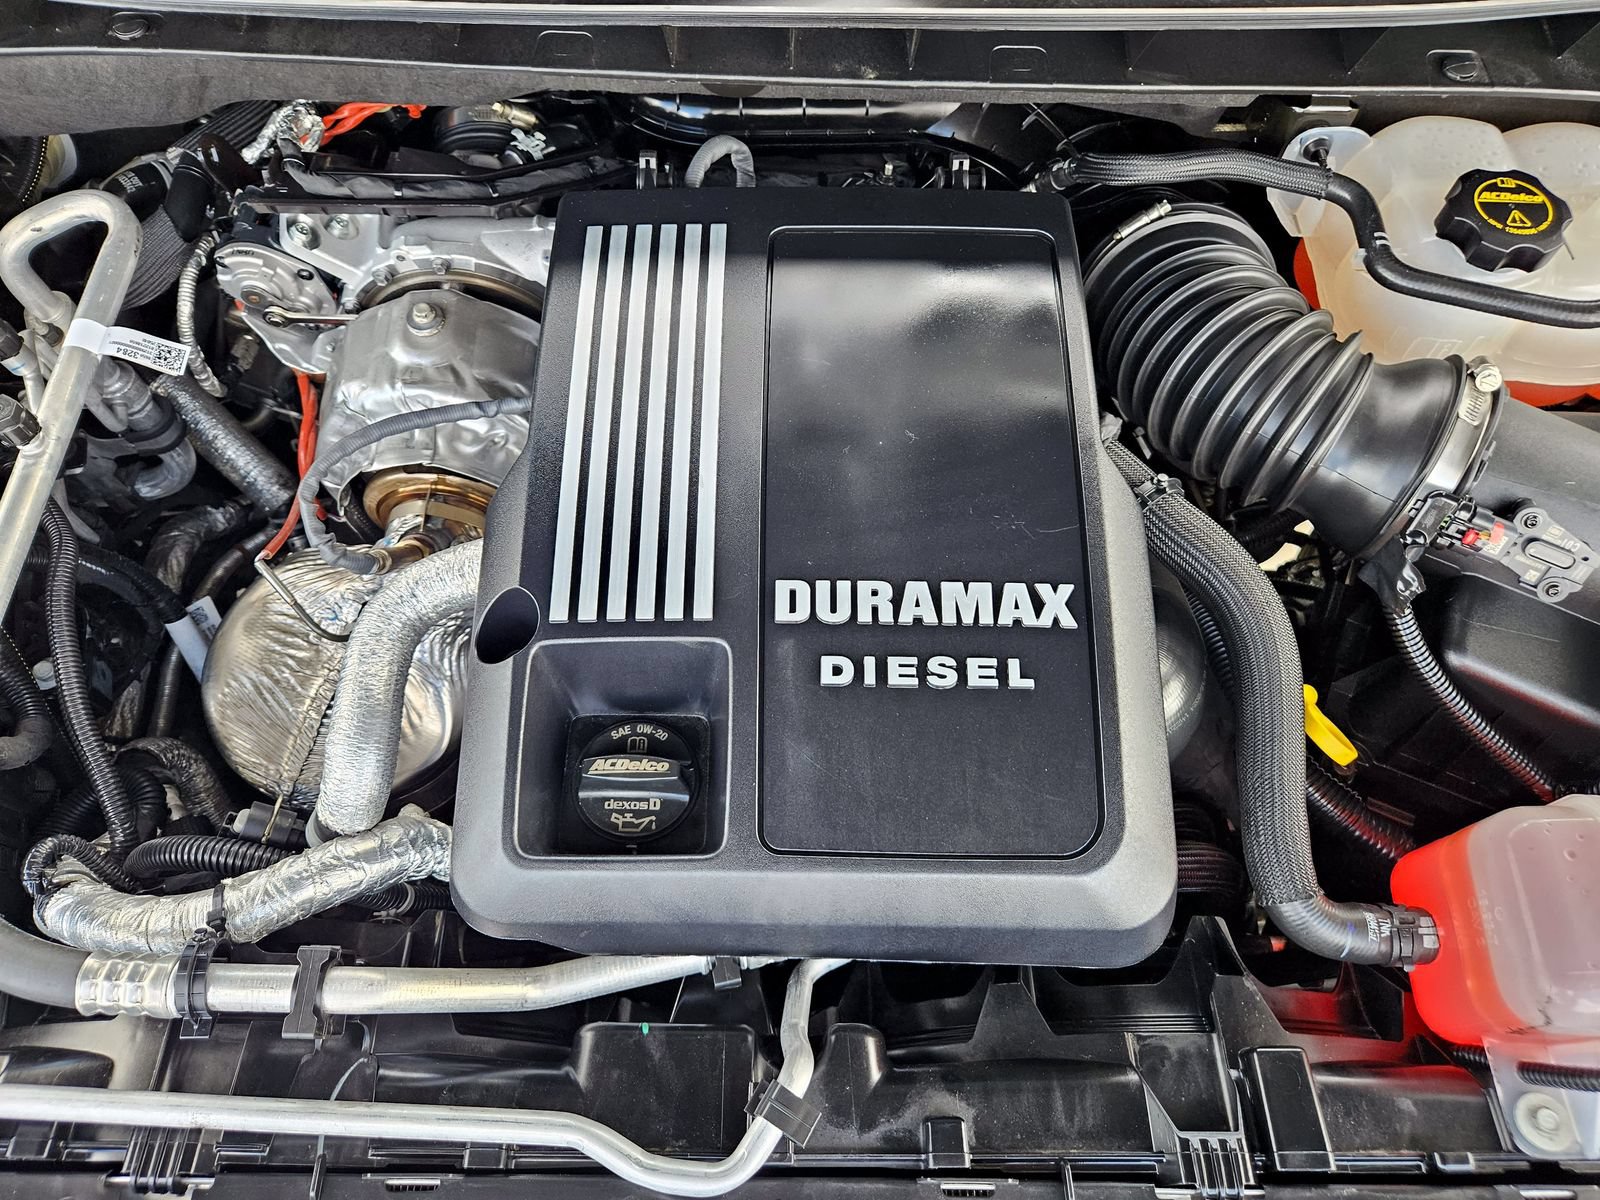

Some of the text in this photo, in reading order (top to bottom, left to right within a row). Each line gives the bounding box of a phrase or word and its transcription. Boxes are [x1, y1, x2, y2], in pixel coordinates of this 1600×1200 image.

[1478, 191, 1544, 203] ACDelco
[116, 346, 139, 359] 3284
[774, 579, 1078, 629] DURAMAX
[820, 655, 1035, 690] DIESEL
[610, 724, 669, 741] SAE 0W-20
[588, 758, 671, 773] ACDelco
[604, 798, 661, 811] dexosD
